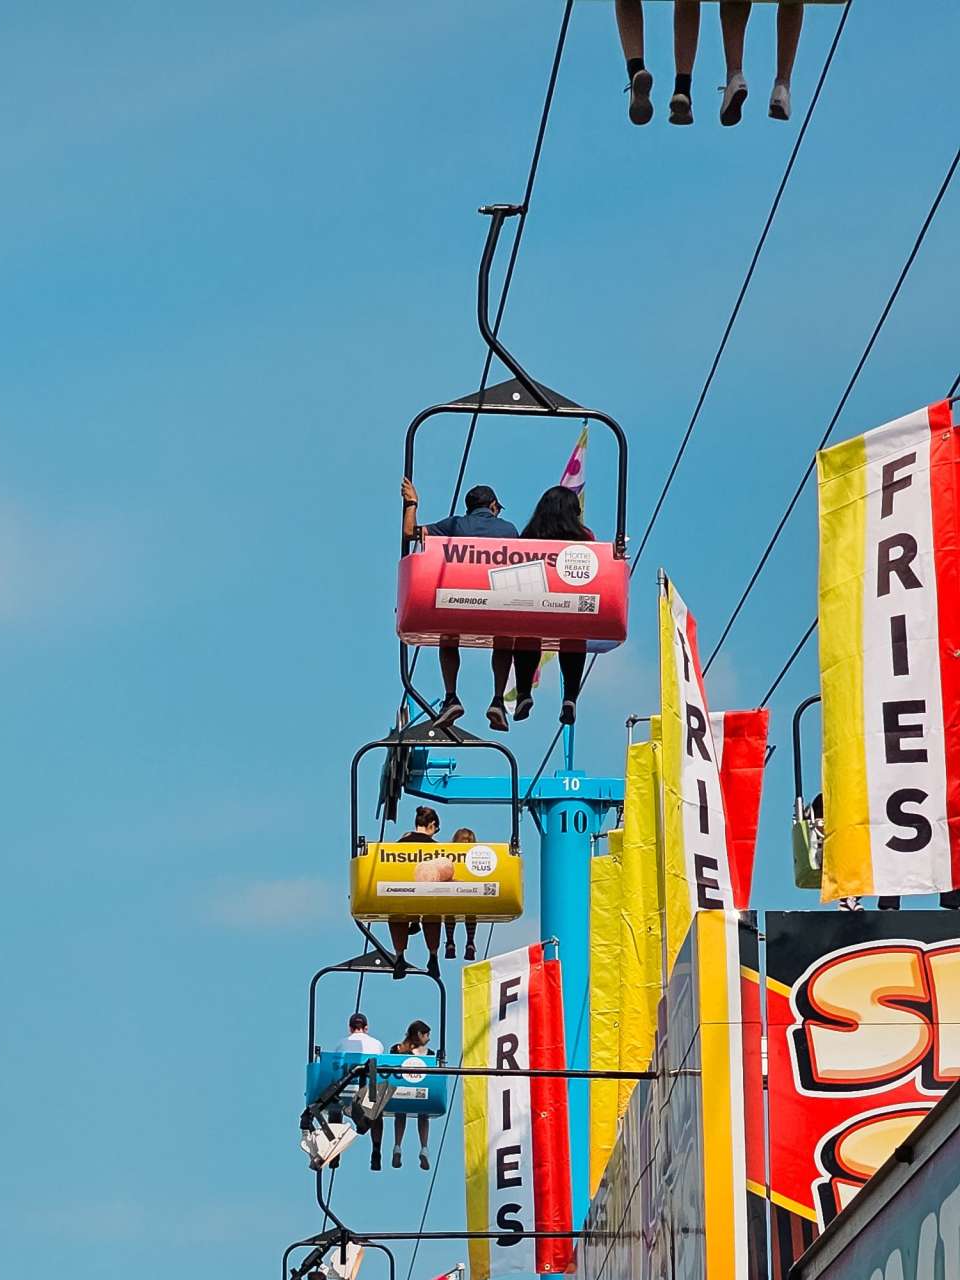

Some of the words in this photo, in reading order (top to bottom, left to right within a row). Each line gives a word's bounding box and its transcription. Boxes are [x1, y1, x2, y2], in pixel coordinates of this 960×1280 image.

[442, 543, 558, 568] Windows
[564, 570, 591, 579] PLUS
[448, 596, 488, 606] ENBRIDGE
[876, 451, 933, 853] FRIES
[562, 777, 581, 791] 10
[558, 809, 588, 834] 10
[380, 848, 466, 863] Insulation
[496, 976, 525, 1247] FRIES
